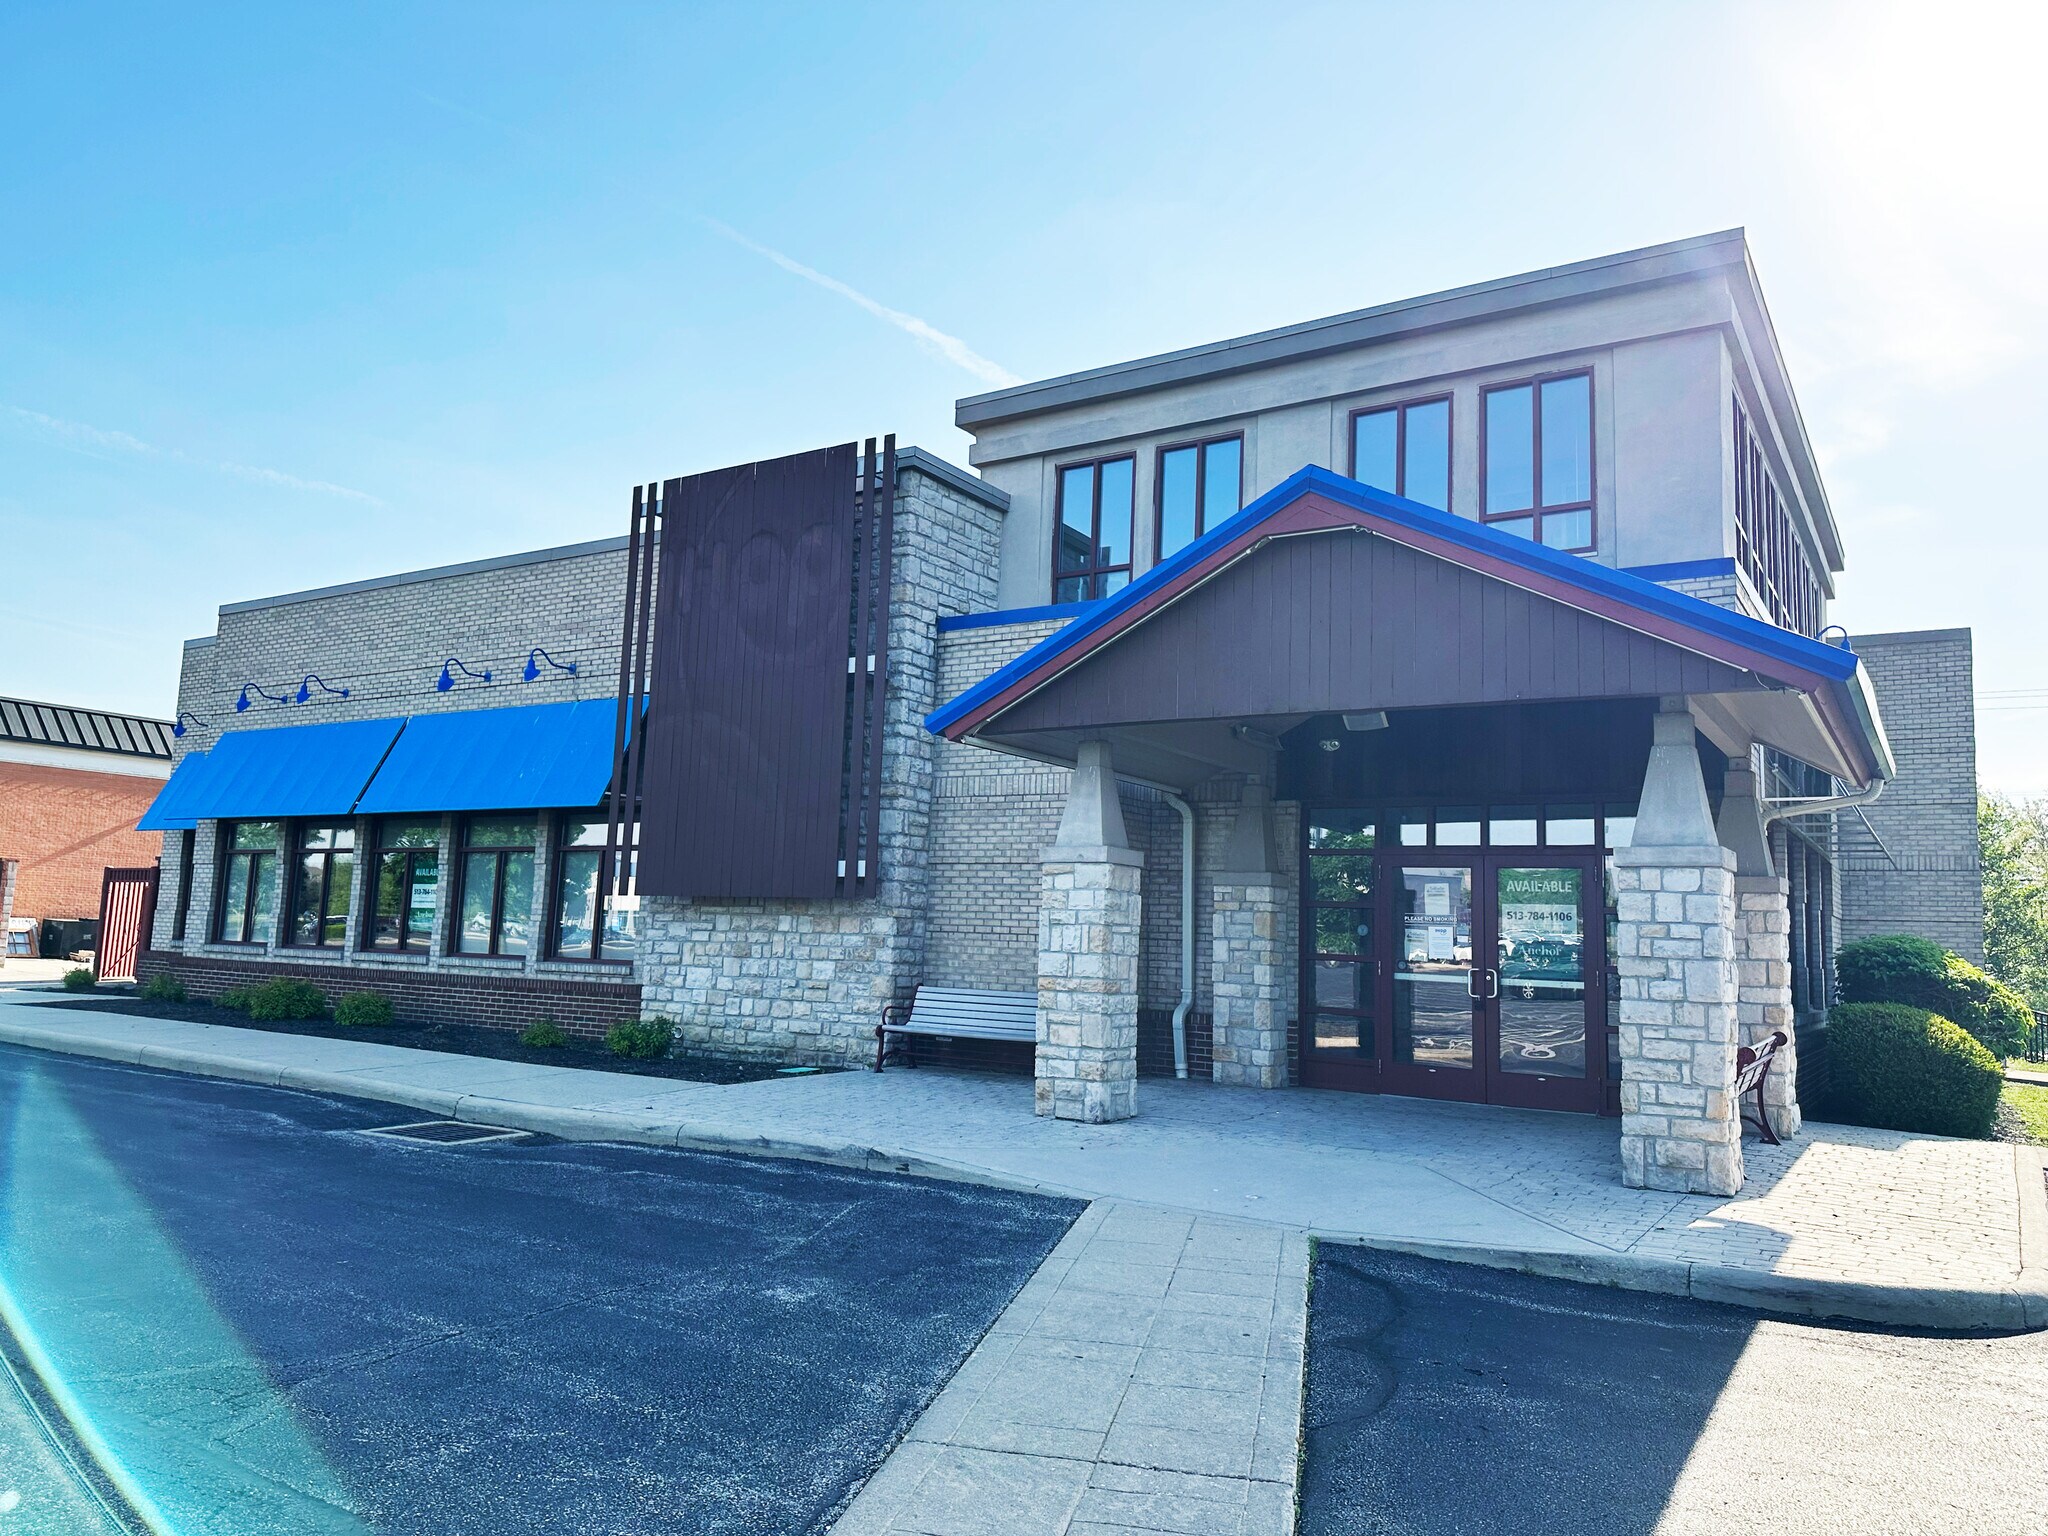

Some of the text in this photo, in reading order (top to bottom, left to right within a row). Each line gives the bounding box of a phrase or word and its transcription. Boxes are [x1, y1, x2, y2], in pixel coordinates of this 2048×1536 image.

[1506, 880, 1572, 893] AVAILABLE
[1507, 911, 1572, 921] 513-784-1106
[1518, 944, 1562, 956] Anchor
